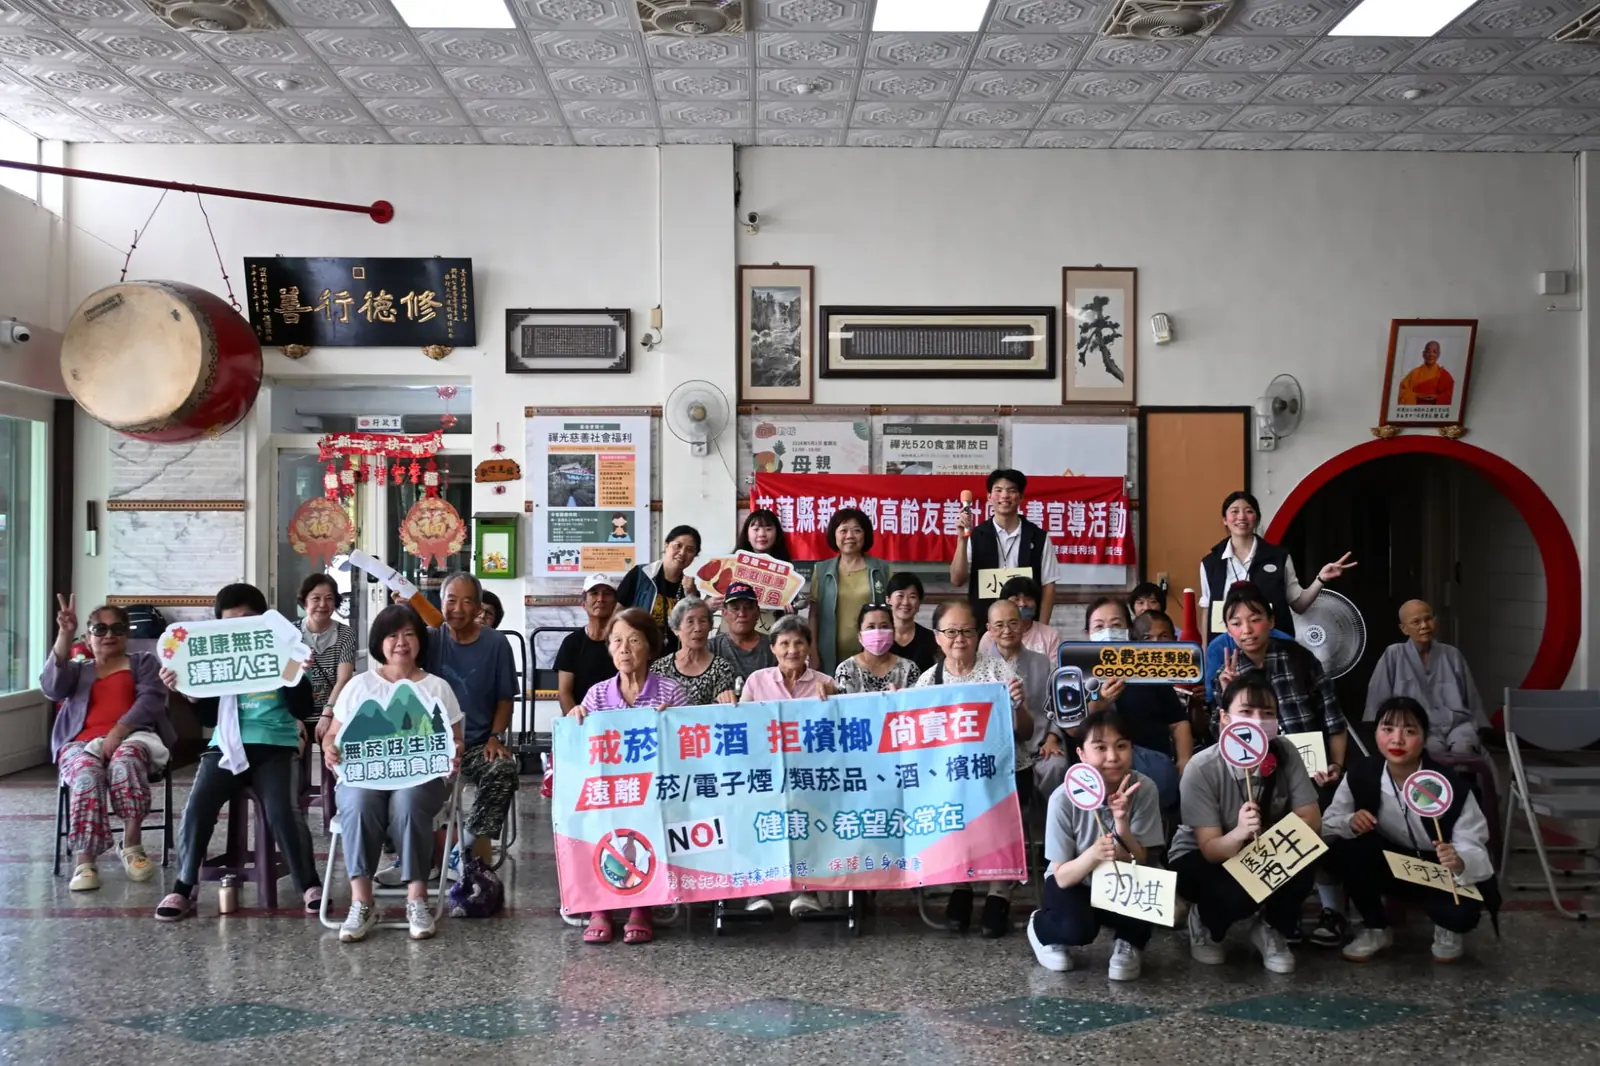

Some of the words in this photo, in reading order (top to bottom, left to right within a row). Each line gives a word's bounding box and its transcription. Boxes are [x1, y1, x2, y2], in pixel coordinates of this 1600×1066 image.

[547, 432, 633, 444] 禪光慈善社會福利
[986, 573, 1022, 594] 小
[187, 629, 275, 657] 健康無菸
[188, 653, 280, 686] 清新人生
[1101, 649, 1191, 666] 免費戒菸專線
[1094, 667, 1198, 679] 0800-636363
[344, 734, 446, 760] 無菸好生活
[588, 726, 659, 766] 戒菸
[677, 722, 749, 760] 節酒
[766, 716, 873, 754] 拒檳榔
[345, 754, 451, 783] 健康無負擔
[585, 777, 641, 807] 遠離
[667, 817, 725, 853] NO!
[1239, 829, 1320, 891] 醫生
